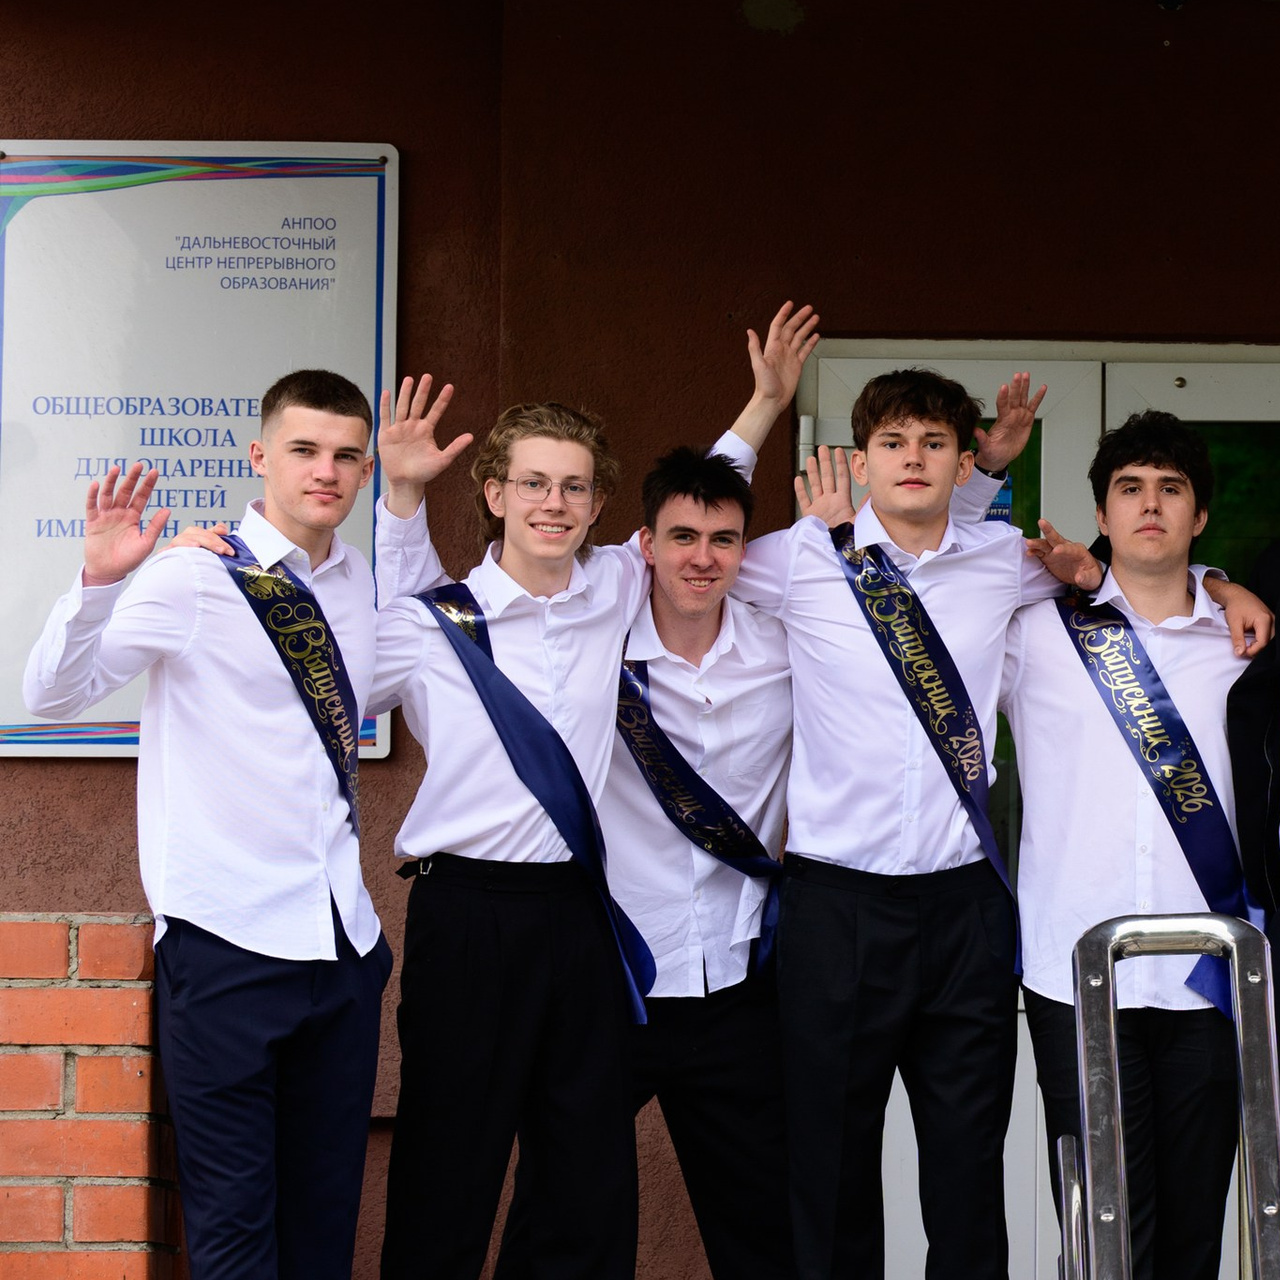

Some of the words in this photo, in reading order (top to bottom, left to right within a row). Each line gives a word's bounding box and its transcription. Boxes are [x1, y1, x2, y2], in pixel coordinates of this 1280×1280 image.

[281, 217, 337, 230] АНПОО
[175, 236, 336, 251] "ДАЛЬНЕВОСТОЧНЫЙ
[166, 257, 213, 271] ЦЕНТР
[217, 257, 336, 270] НЕПРЕРЫВНОГО
[220, 276, 336, 291] ОБРАЗОВАНИЯ"
[32, 396, 262, 419] ОБЩЕОБРАЗОВАТЕ
[139, 428, 237, 447] ШКОЛА
[74, 457, 127, 480] ДЛЯ
[146, 484, 226, 508] ДЕТЕЙ
[853, 566, 958, 735] Выпускник
[948, 727, 984, 782] 2026
[265, 602, 357, 773] Выпускник
[1068, 609, 1172, 763] Выпускник
[1160, 758, 1214, 814] 2026
